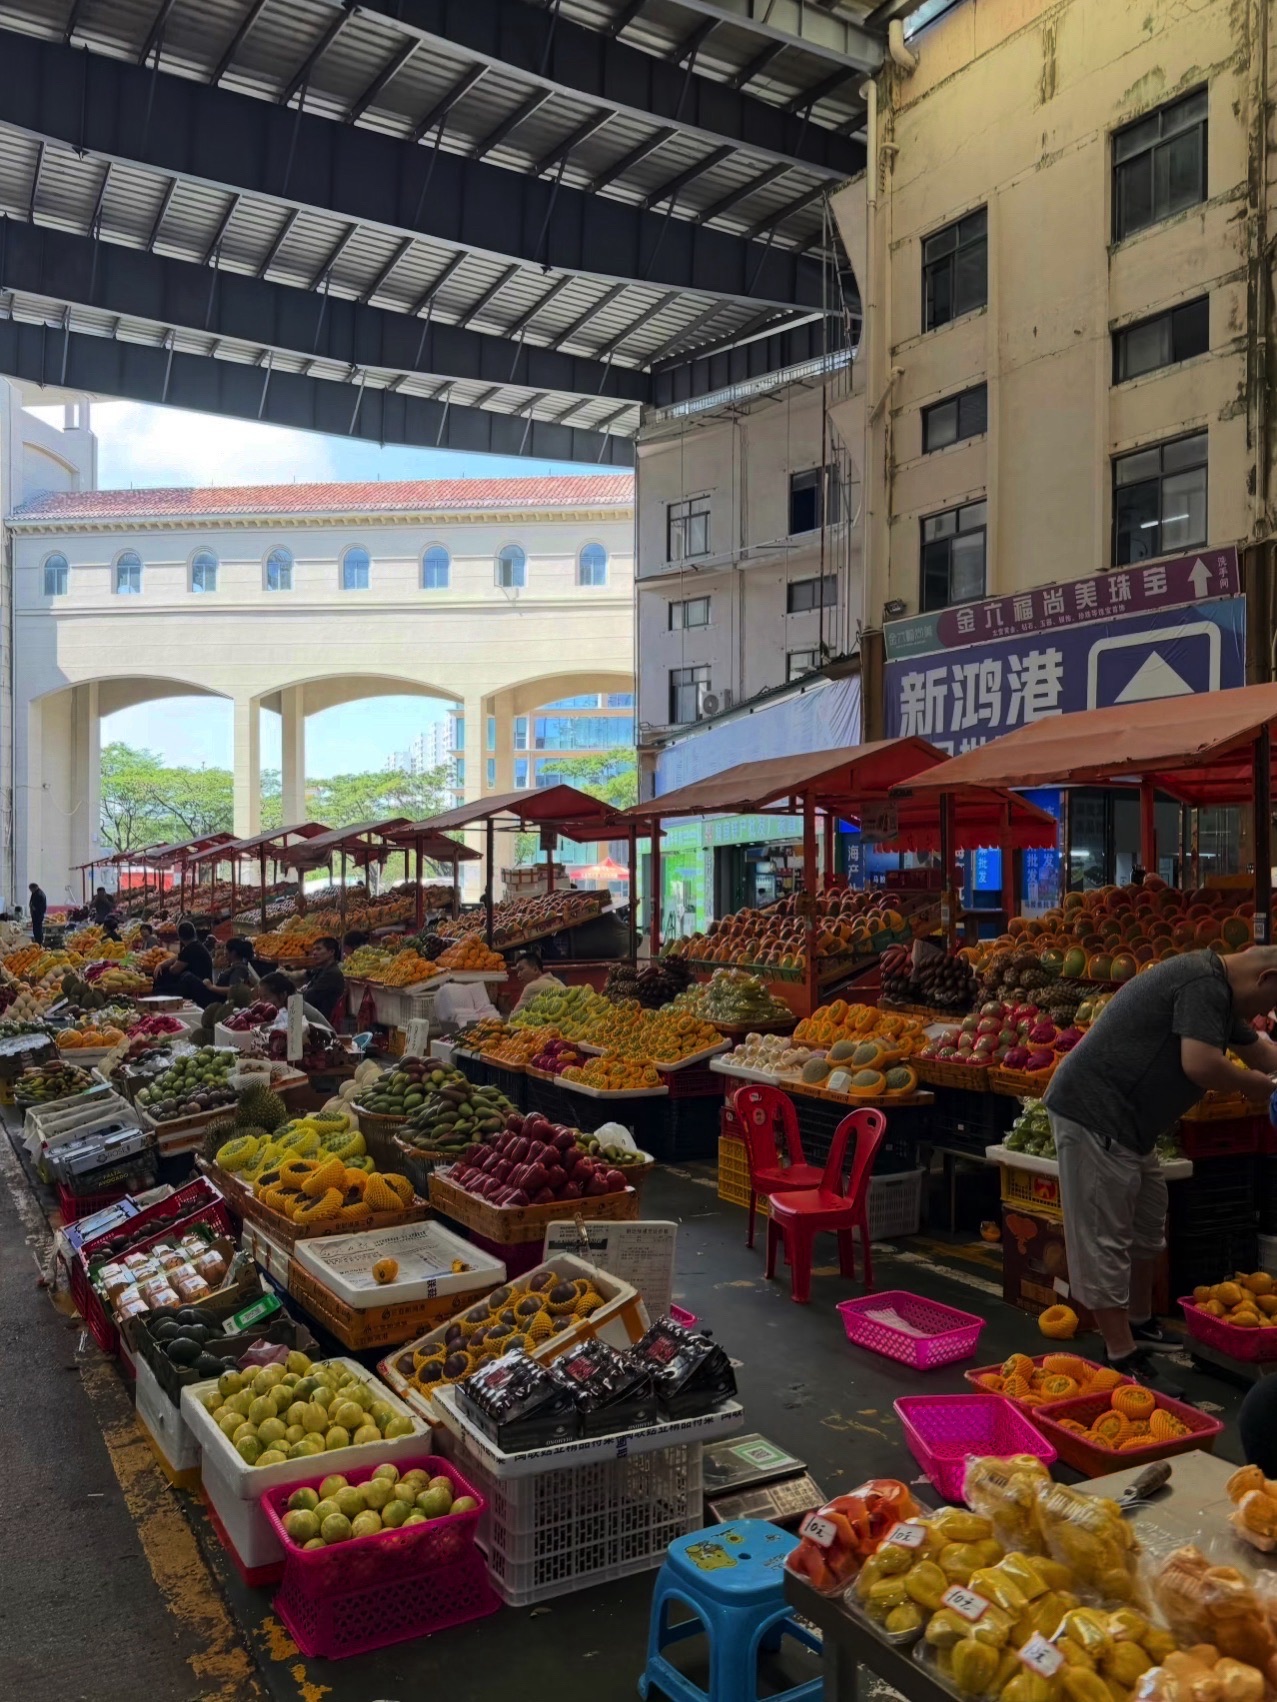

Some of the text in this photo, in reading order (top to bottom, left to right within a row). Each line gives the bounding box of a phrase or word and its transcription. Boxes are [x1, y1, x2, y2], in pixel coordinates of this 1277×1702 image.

[1217, 555, 1229, 590] 洗手间
[957, 566, 1168, 634] 金六福尚美珠宝
[900, 647, 1064, 738] 新鸿港
[98, 1173, 129, 1187] AVOCADO
[804, 1516, 825, 1538] 10元
[889, 1528, 912, 1542] 10元
[946, 1590, 972, 1611] 10元
